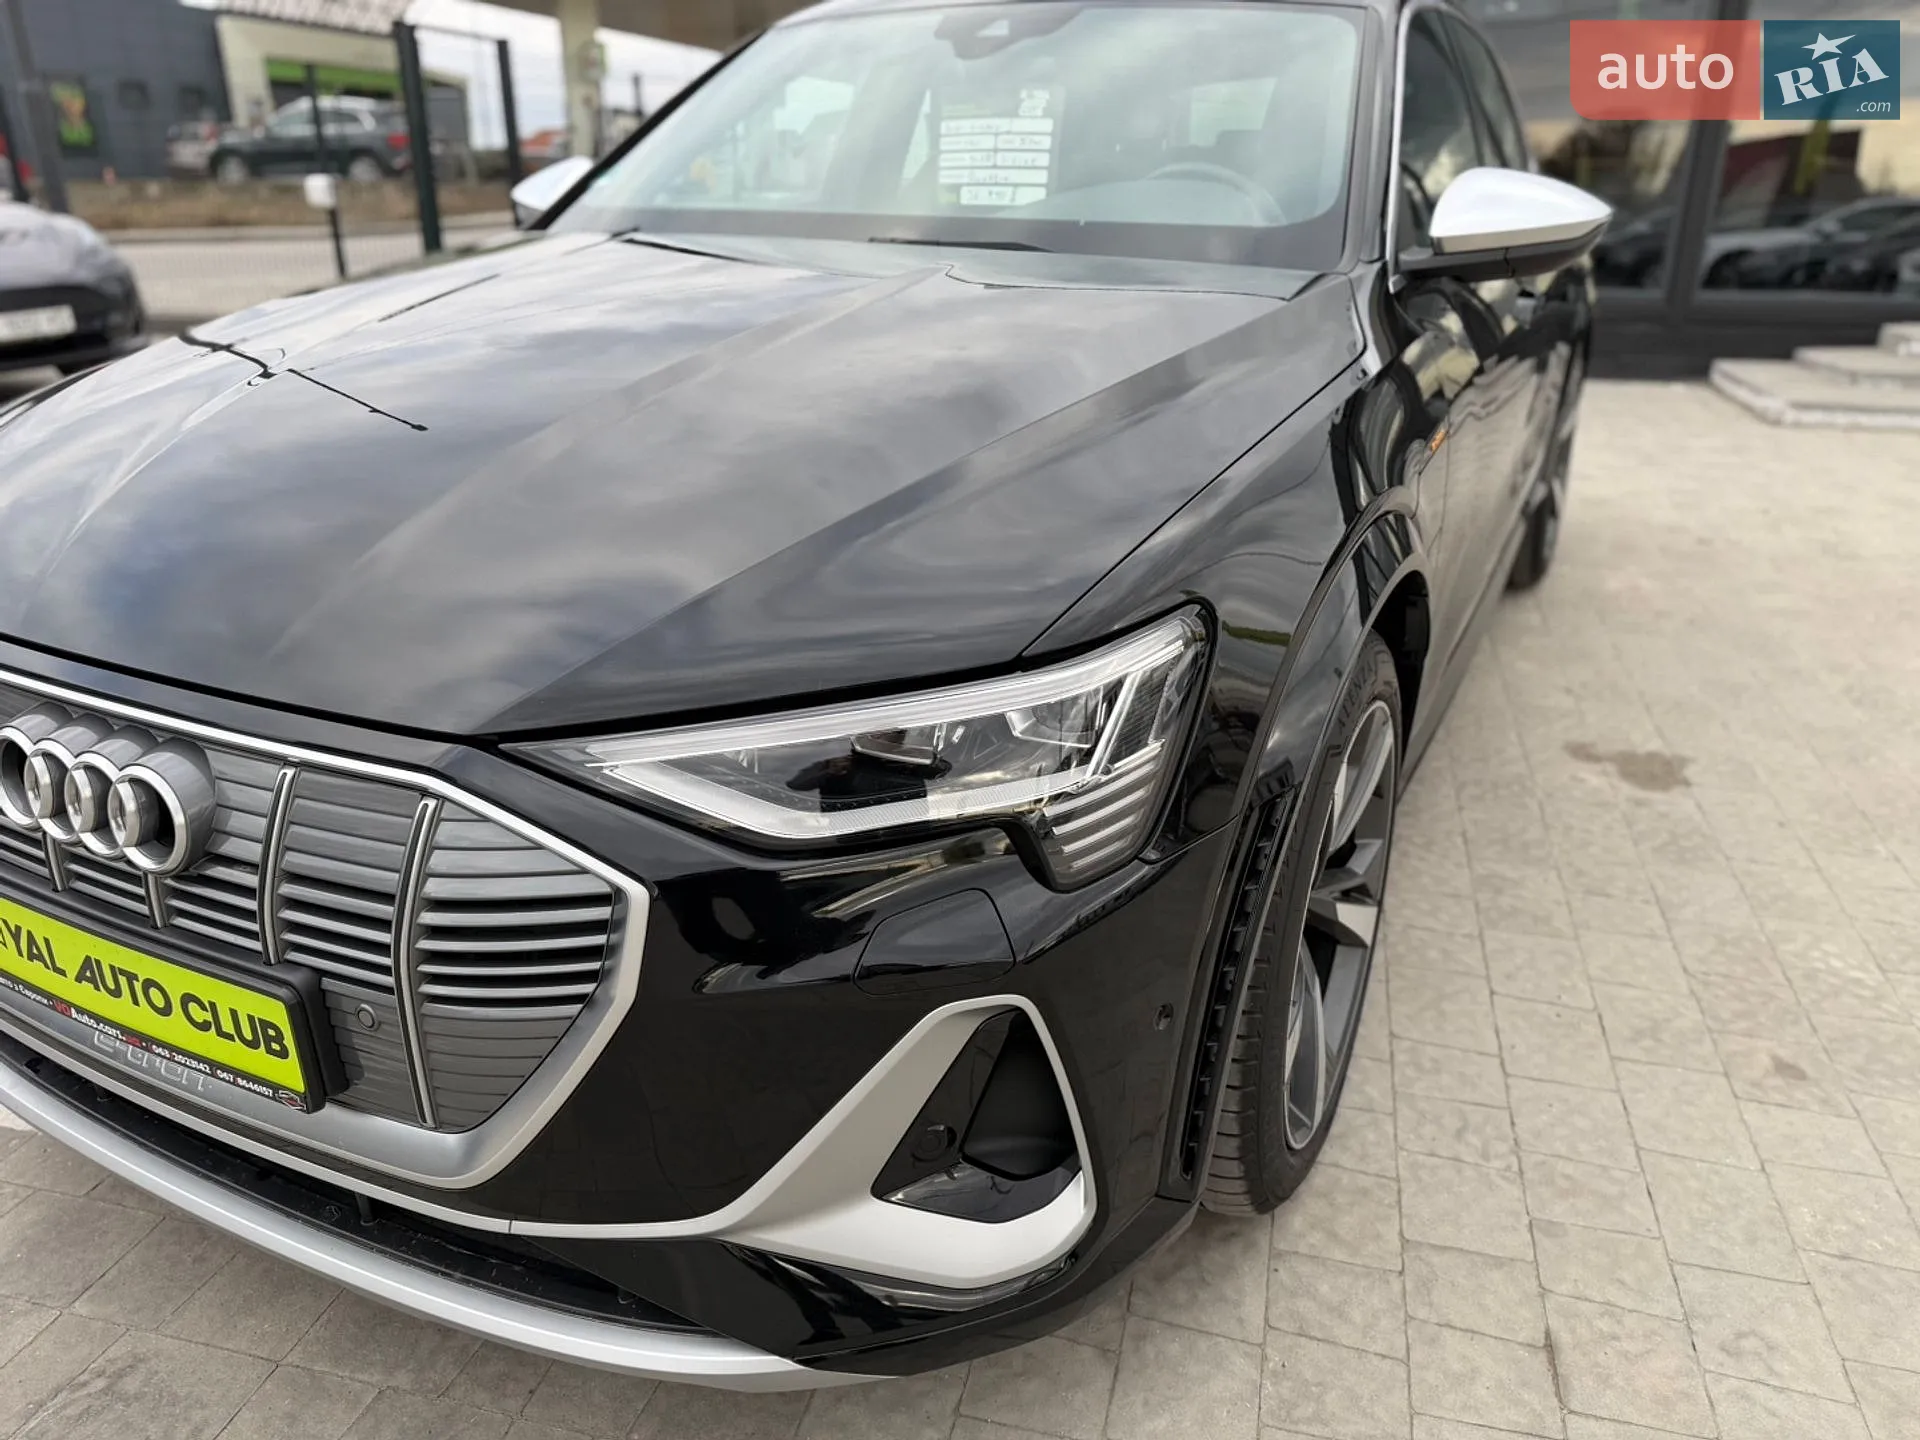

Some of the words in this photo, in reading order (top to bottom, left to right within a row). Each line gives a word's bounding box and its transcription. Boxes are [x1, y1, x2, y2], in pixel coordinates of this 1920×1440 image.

[0, 917, 68, 979] YAL
[74, 954, 174, 1018] AUTO
[179, 992, 290, 1060] CLUB
